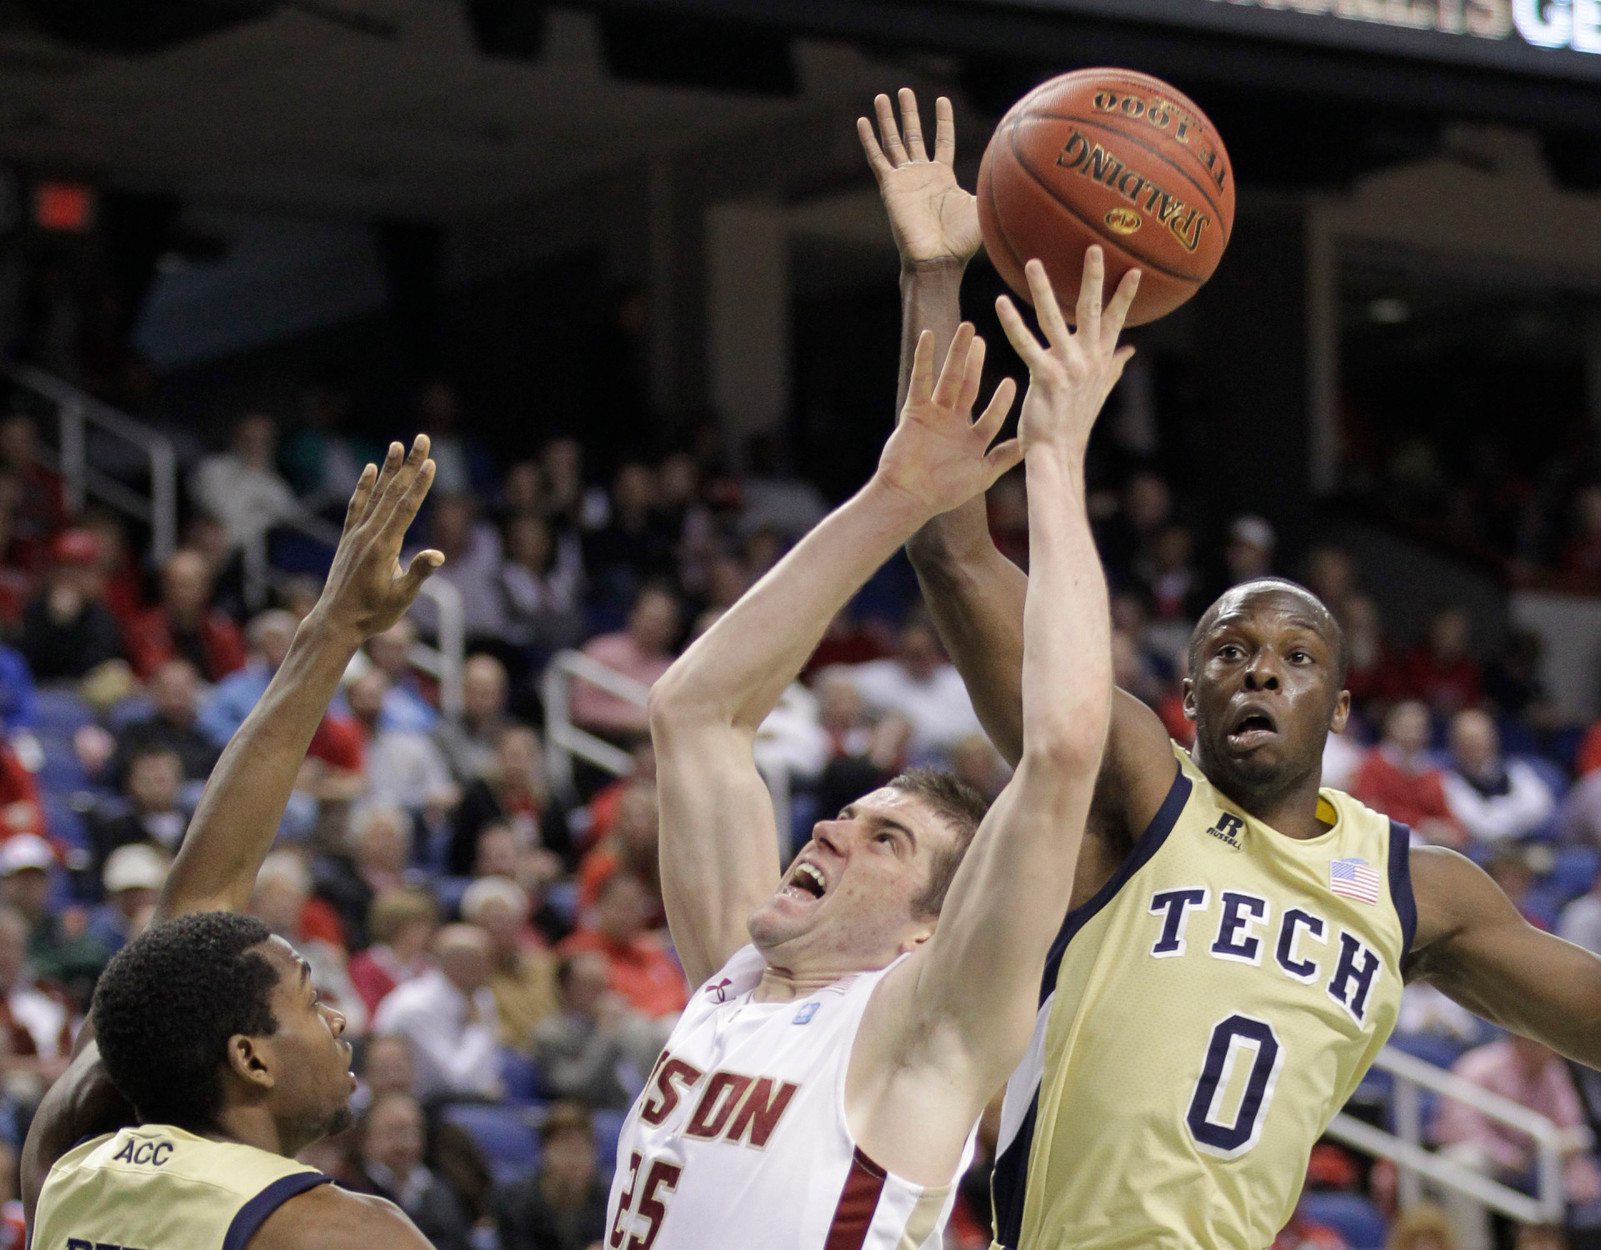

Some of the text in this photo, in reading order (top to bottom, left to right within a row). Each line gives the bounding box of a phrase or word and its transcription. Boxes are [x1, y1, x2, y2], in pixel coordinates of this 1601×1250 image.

[1056, 131, 1211, 253] SPALDING
[1206, 827, 1242, 850] RUSSELL
[1148, 886, 1381, 1032] TECH
[1184, 1010, 1286, 1160] 0
[114, 1140, 174, 1167] ACC
